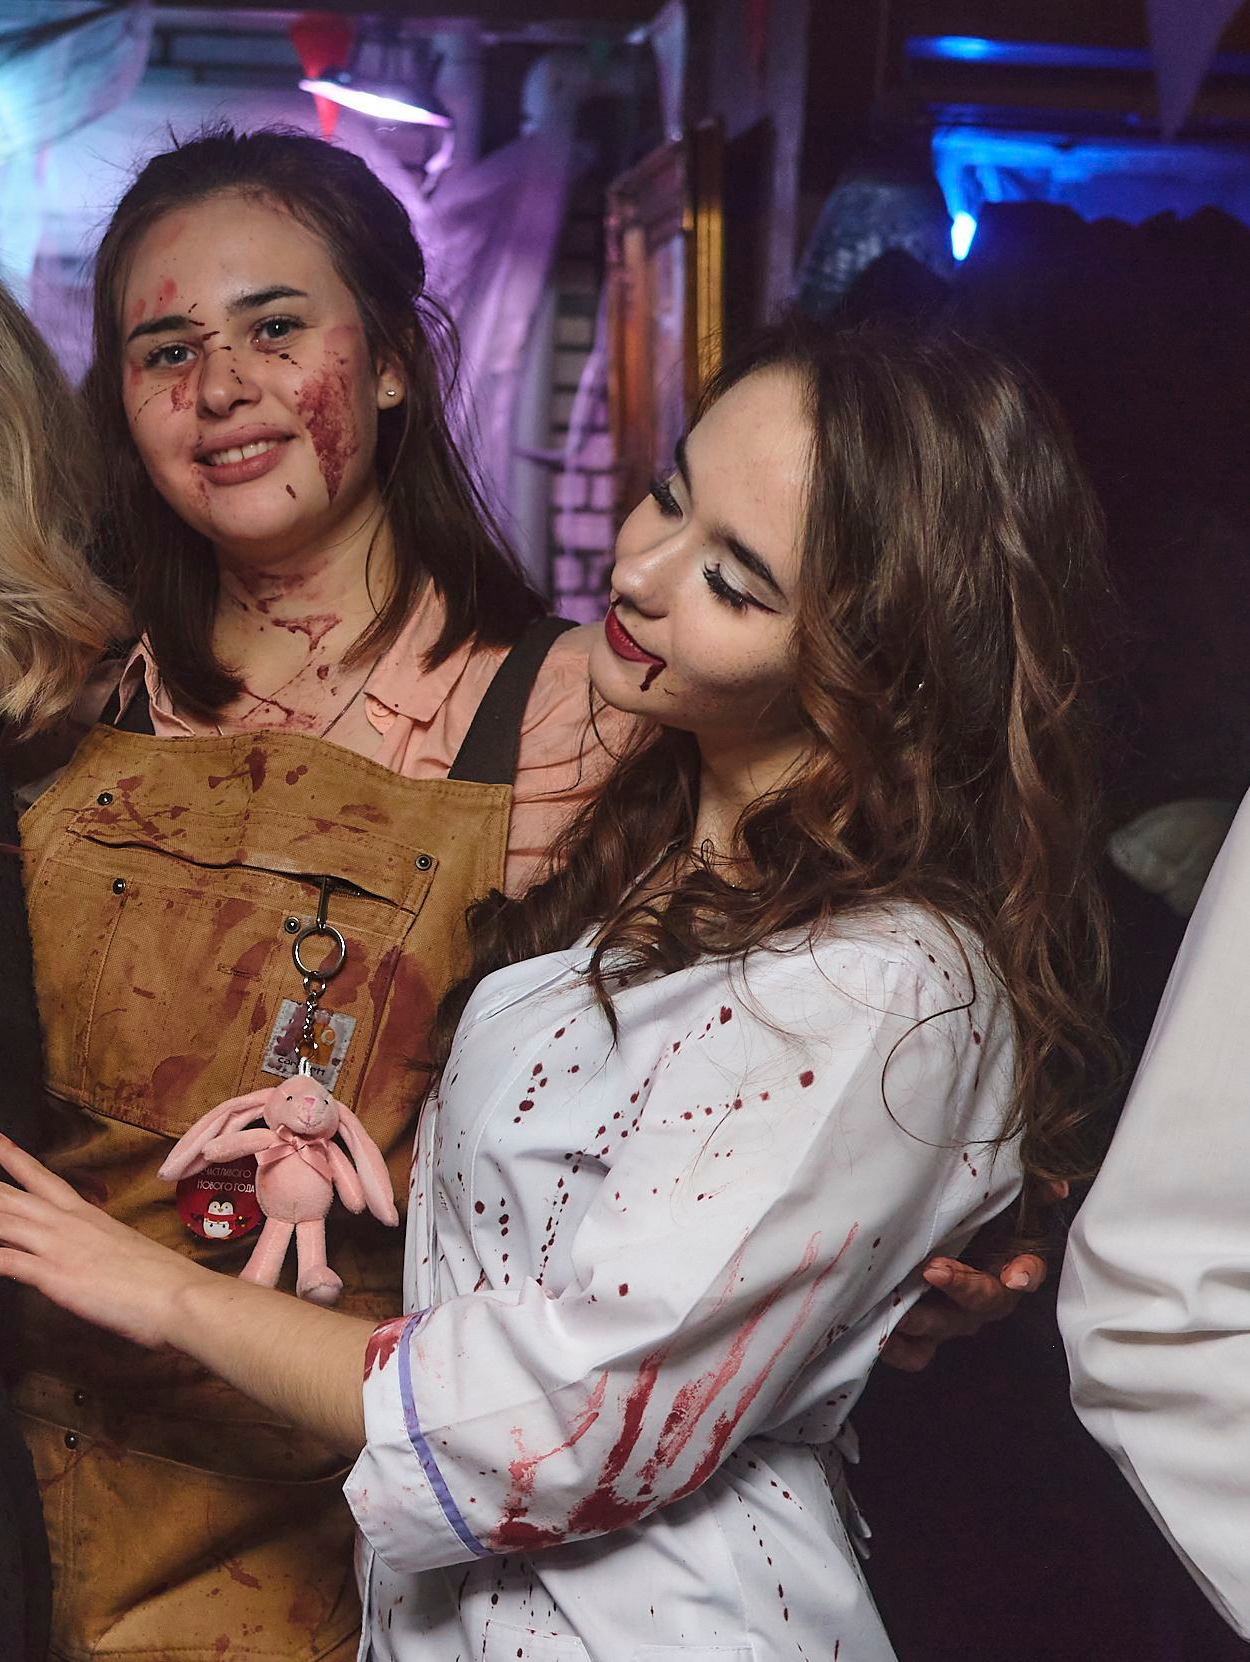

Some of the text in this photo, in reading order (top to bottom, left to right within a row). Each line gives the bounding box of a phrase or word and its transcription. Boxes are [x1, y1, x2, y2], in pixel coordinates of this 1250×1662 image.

[277, 1057, 326, 1077] carrtt
[197, 1179, 255, 1193] НОВОГО ГОДА
